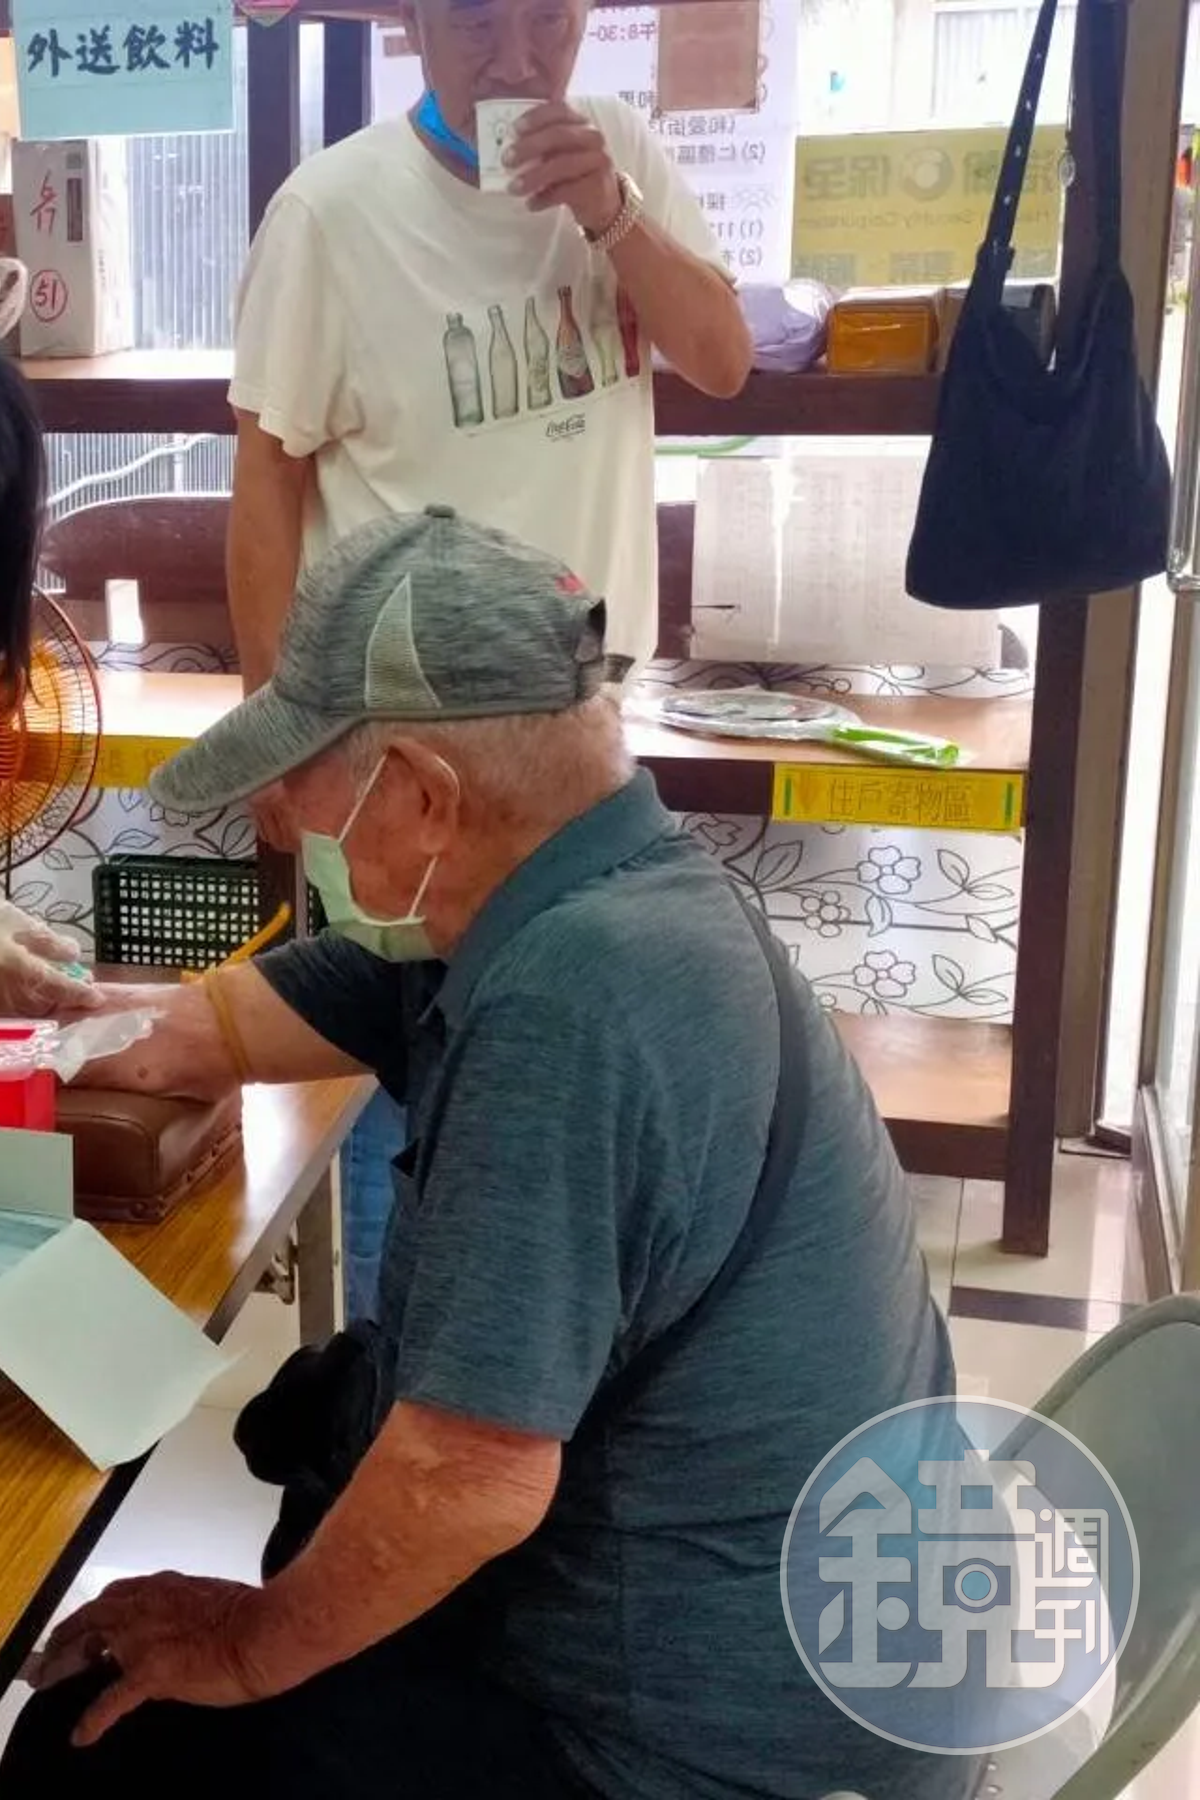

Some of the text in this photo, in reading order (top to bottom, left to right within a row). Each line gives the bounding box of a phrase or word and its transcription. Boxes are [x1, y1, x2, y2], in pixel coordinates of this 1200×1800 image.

[27, 17, 219, 77] 外送飲料
[35, 278, 58, 311] 51
[829, 777, 973, 823] 住戶寄物區
